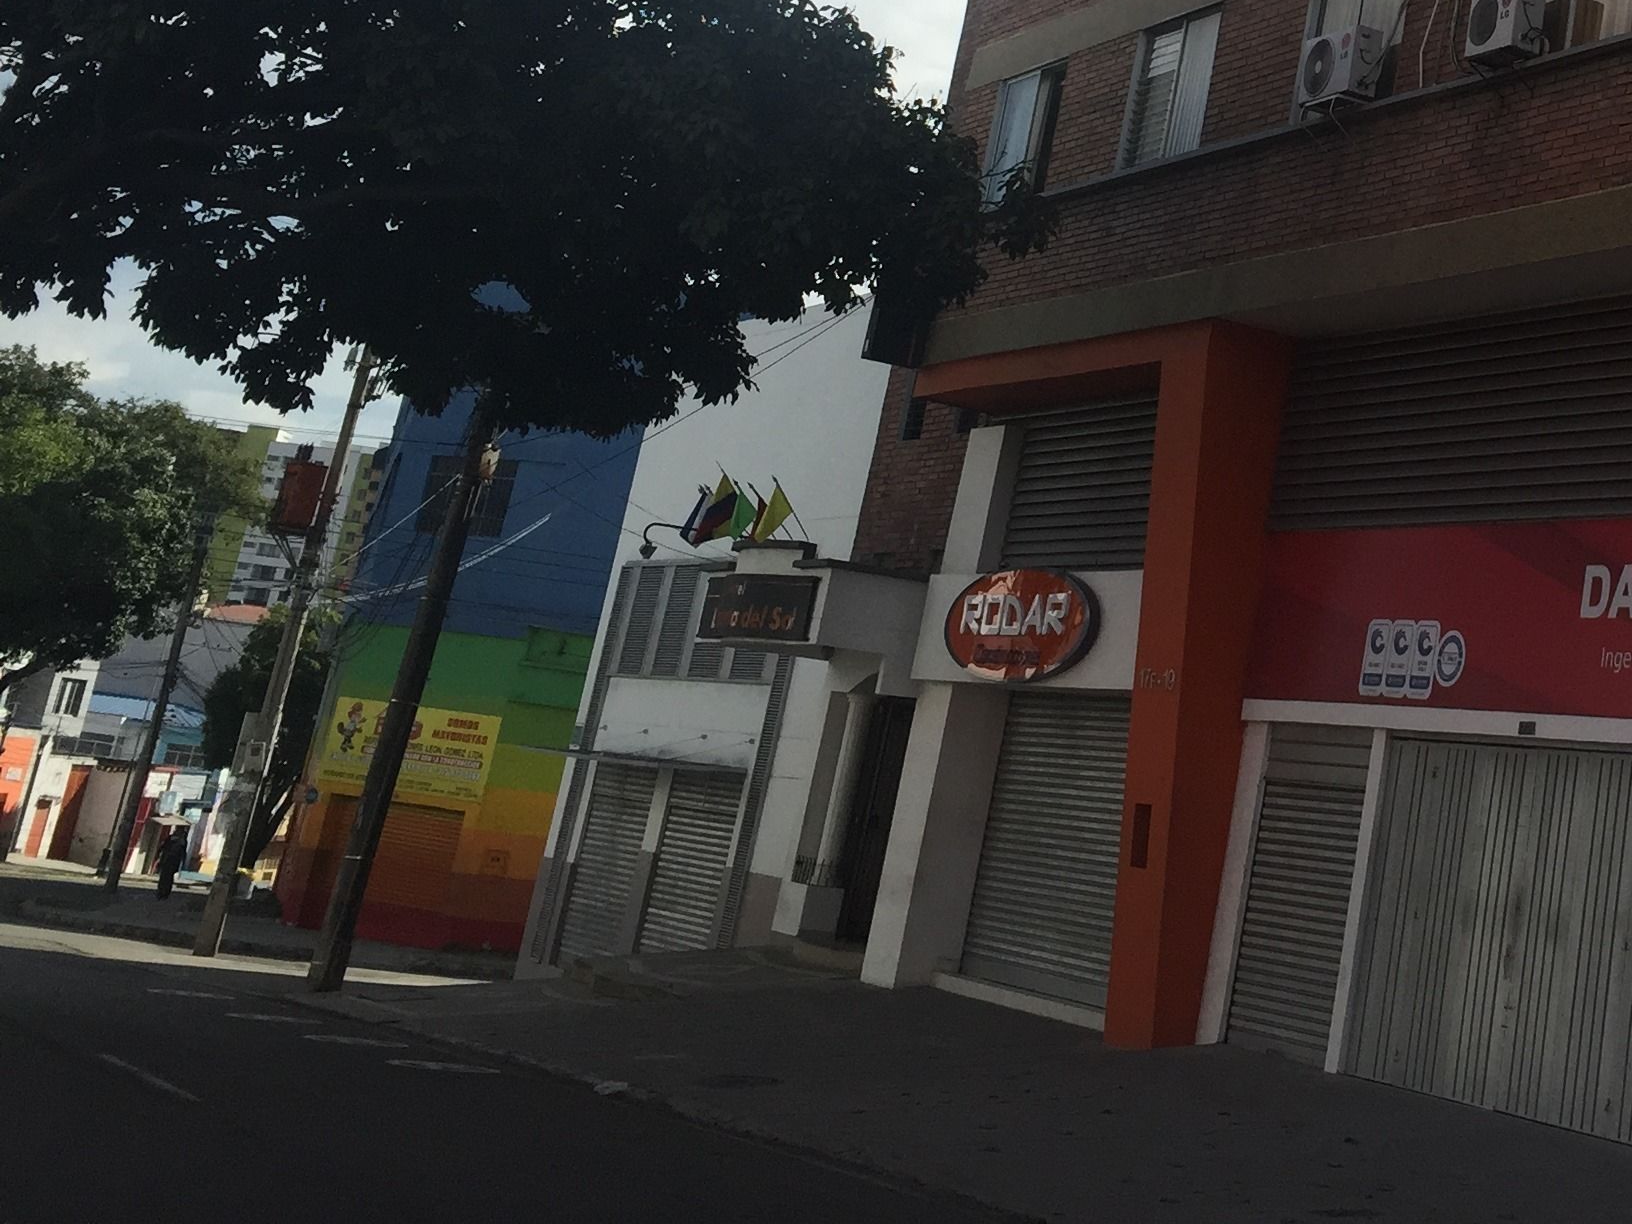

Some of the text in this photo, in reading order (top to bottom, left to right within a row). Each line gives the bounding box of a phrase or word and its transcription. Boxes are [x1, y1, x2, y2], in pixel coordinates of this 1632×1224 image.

[1500, 9, 1510, 20] LG
[959, 593, 1072, 636] RODAR
[431, 729, 489, 746] MAYORISTAS
